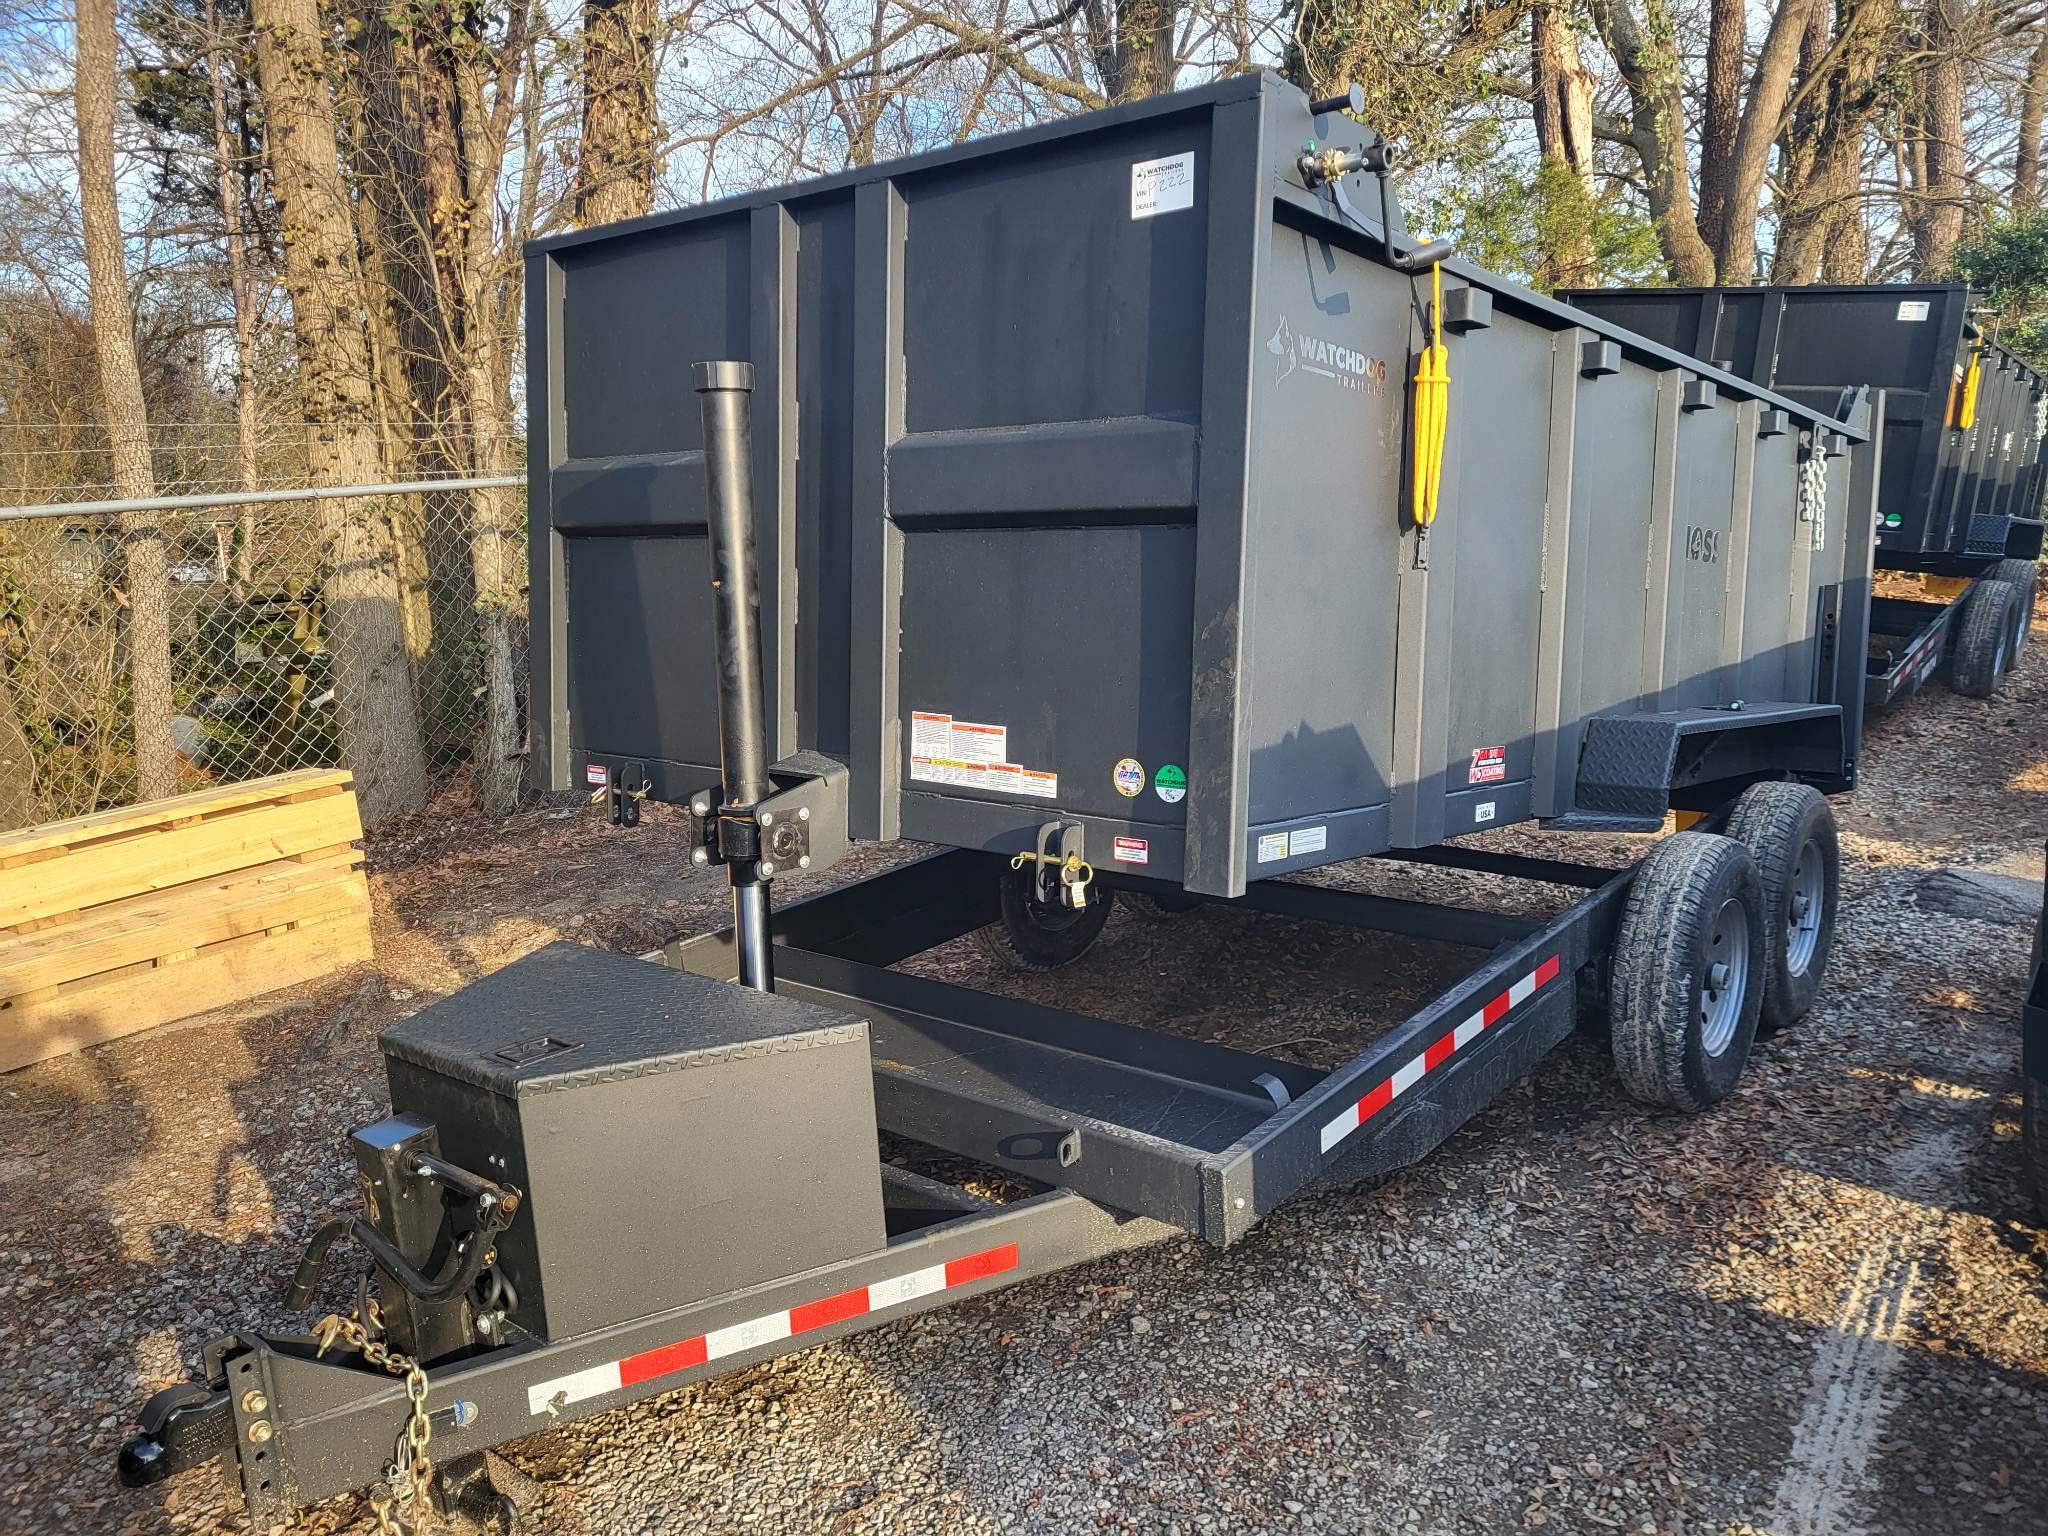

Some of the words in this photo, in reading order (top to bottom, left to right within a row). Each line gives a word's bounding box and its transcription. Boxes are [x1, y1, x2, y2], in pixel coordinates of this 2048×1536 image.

[1147, 161, 1184, 175] WATCHDOG
[1299, 334, 1386, 383] WATCHDOG
[1480, 809, 1491, 818] USA
